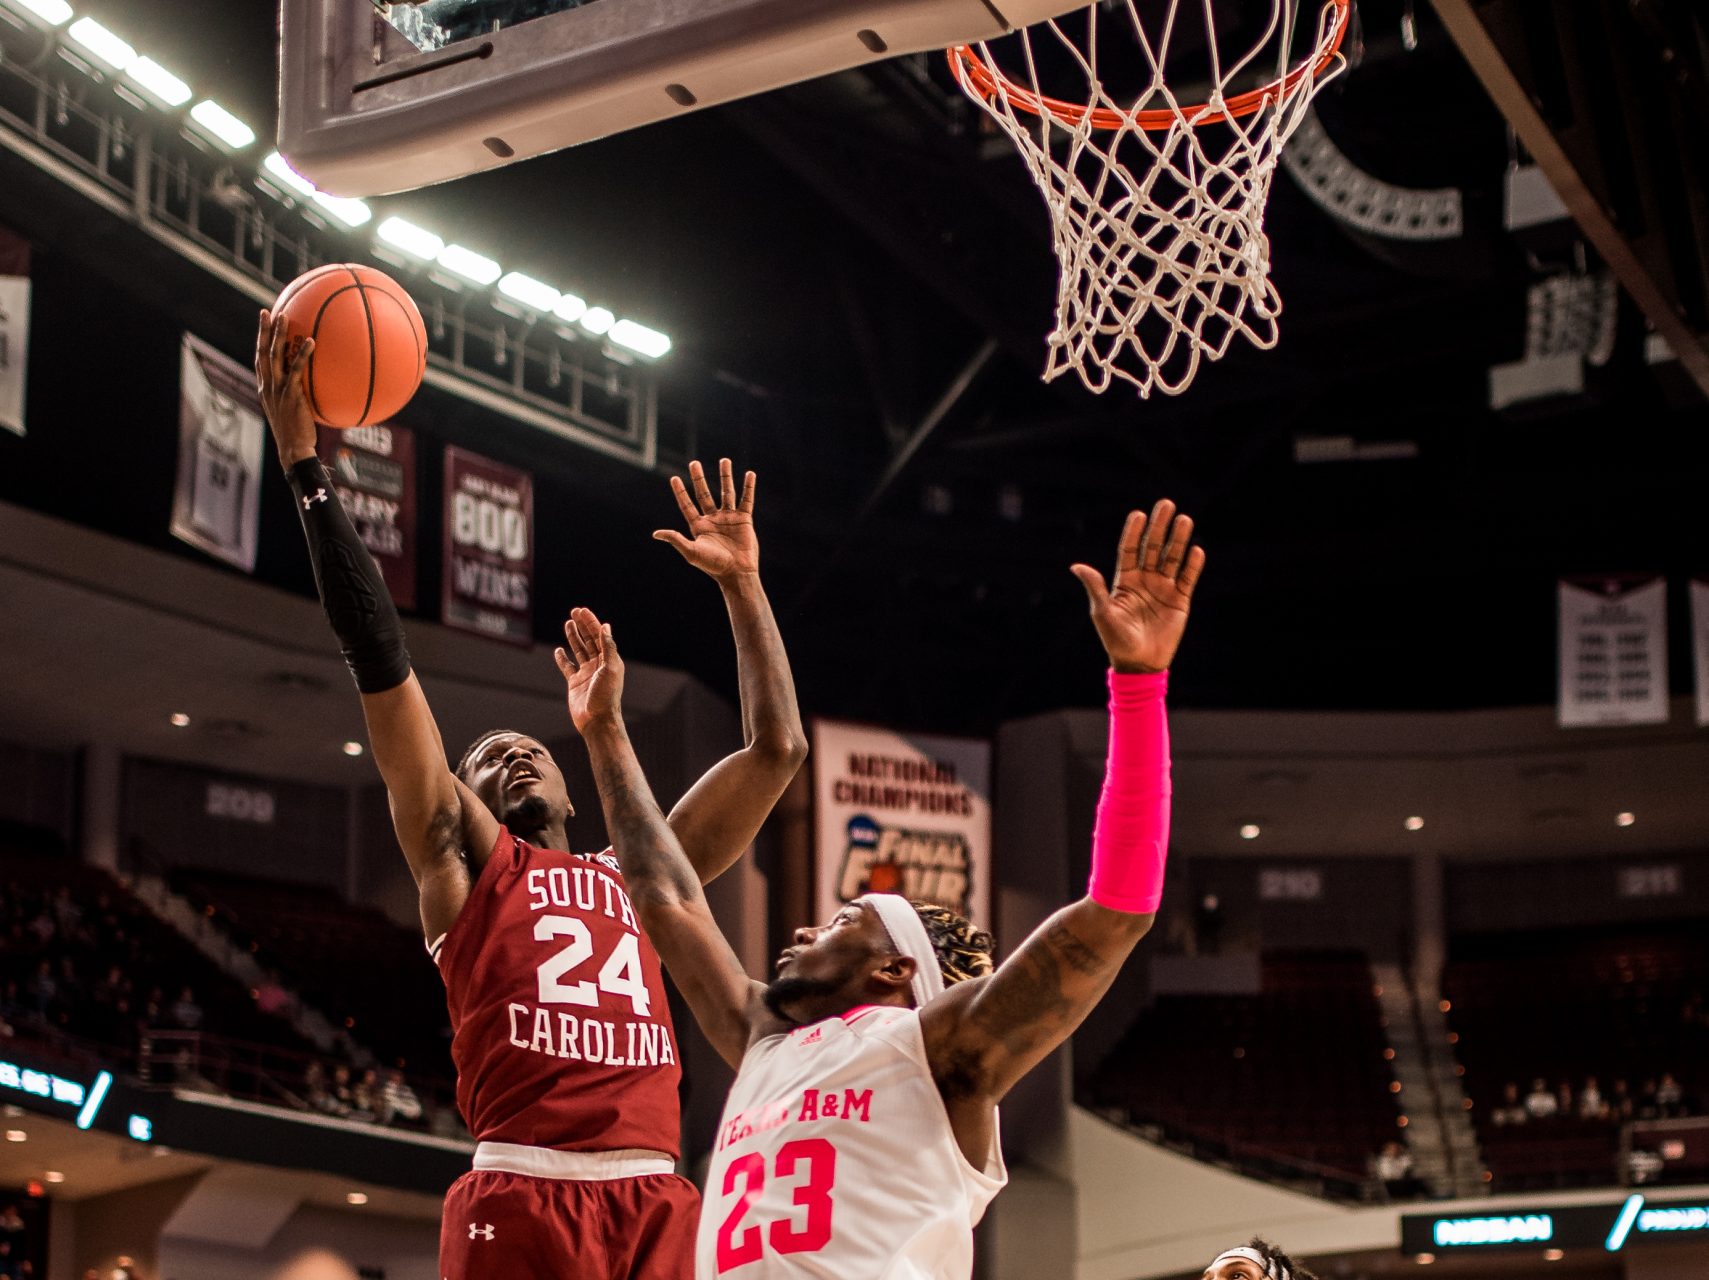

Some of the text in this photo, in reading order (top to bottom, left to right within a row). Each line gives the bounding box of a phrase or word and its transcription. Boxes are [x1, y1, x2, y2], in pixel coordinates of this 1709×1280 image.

[452, 490, 527, 561] 800
[453, 554, 529, 611] WINS
[834, 779, 973, 817] CHAMPIONS
[848, 754, 957, 785] NATIONAL
[878, 829, 967, 867] FINAL
[528, 867, 640, 934] SOUTH
[533, 914, 651, 1017] 24
[508, 1002, 675, 1067] CAROLINA
[797, 1088, 873, 1122] A&M
[716, 1137, 836, 1275] 23
